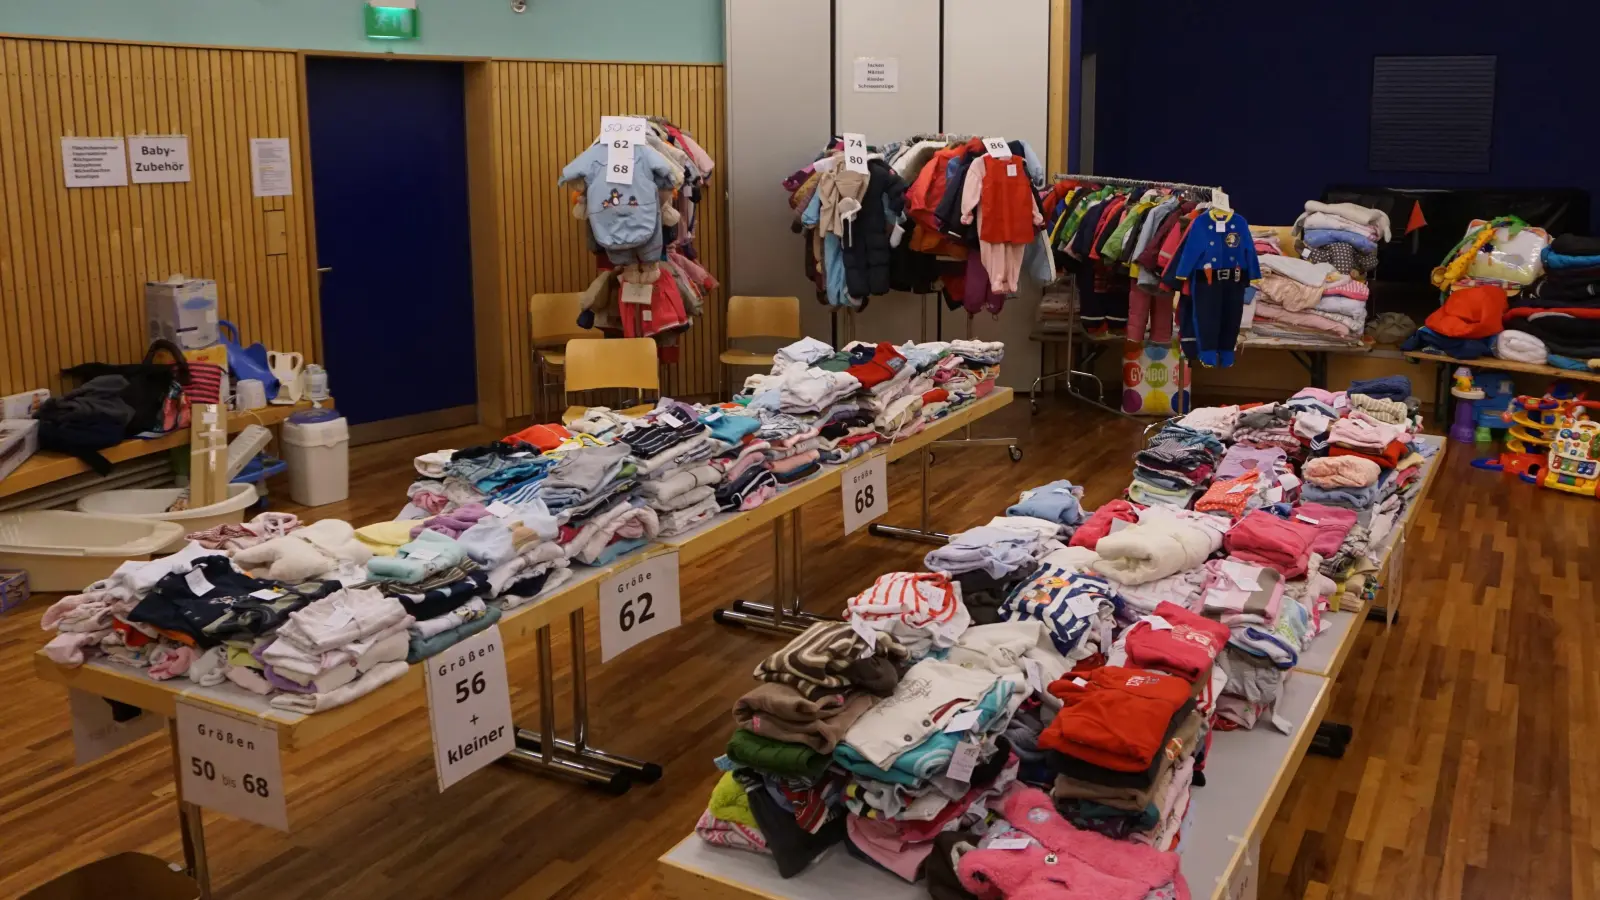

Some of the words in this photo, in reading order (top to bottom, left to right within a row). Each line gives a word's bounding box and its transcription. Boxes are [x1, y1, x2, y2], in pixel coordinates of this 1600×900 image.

[141, 145, 176, 157] Baby-
[613, 139, 629, 149] 62
[849, 139, 863, 149] 74
[989, 141, 1005, 150] 86
[135, 161, 185, 172] Zubehör
[612, 164, 629, 174] 68
[849, 155, 863, 165] 80
[854, 484, 875, 514] 68
[617, 572, 652, 593] Größe
[619, 592, 656, 632] 62
[438, 643, 495, 677] Größen
[455, 671, 486, 704] 56
[197, 723, 255, 751] Größen
[447, 725, 505, 765] kleiner
[191, 756, 216, 781] 50
[221, 774, 237, 789] bis
[242, 773, 270, 798] 68
